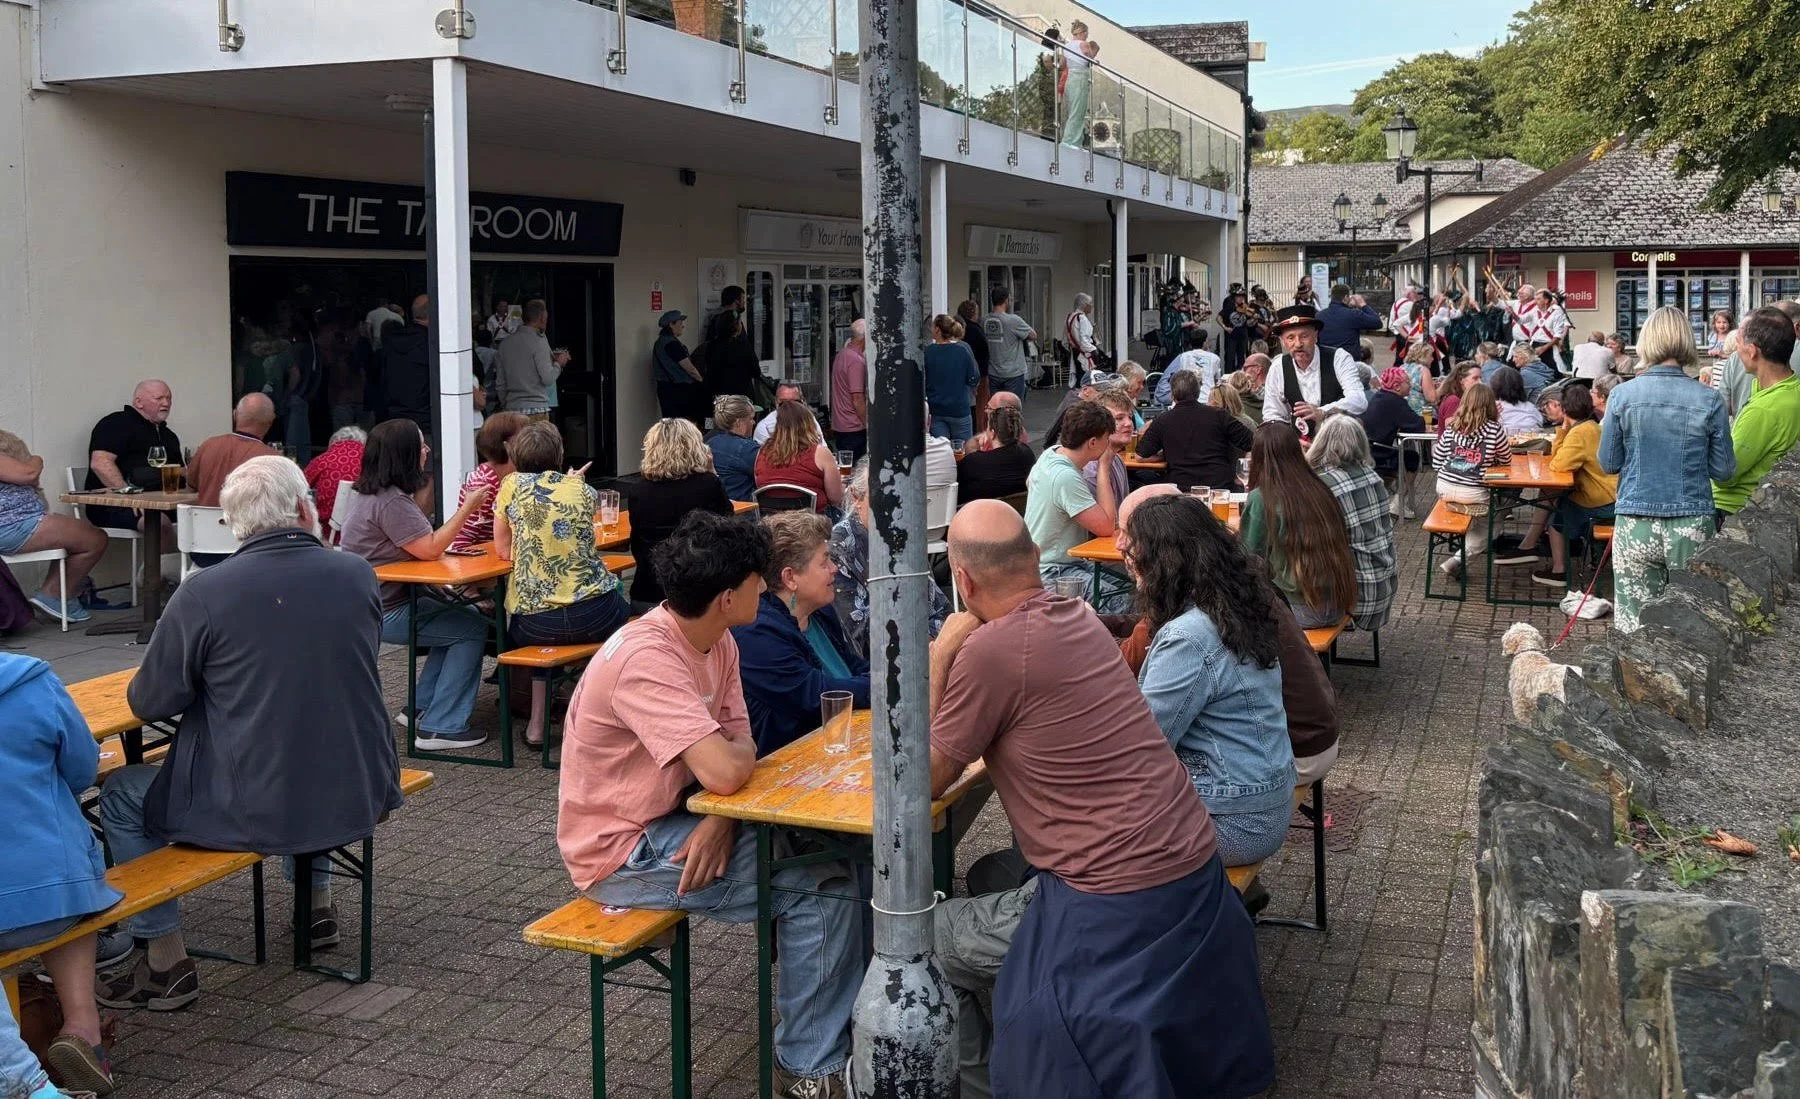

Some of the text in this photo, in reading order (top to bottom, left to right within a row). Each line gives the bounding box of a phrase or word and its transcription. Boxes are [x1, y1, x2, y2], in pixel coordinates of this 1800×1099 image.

[298, 193, 577, 241] THE TROOM
[817, 227, 837, 246] Your
